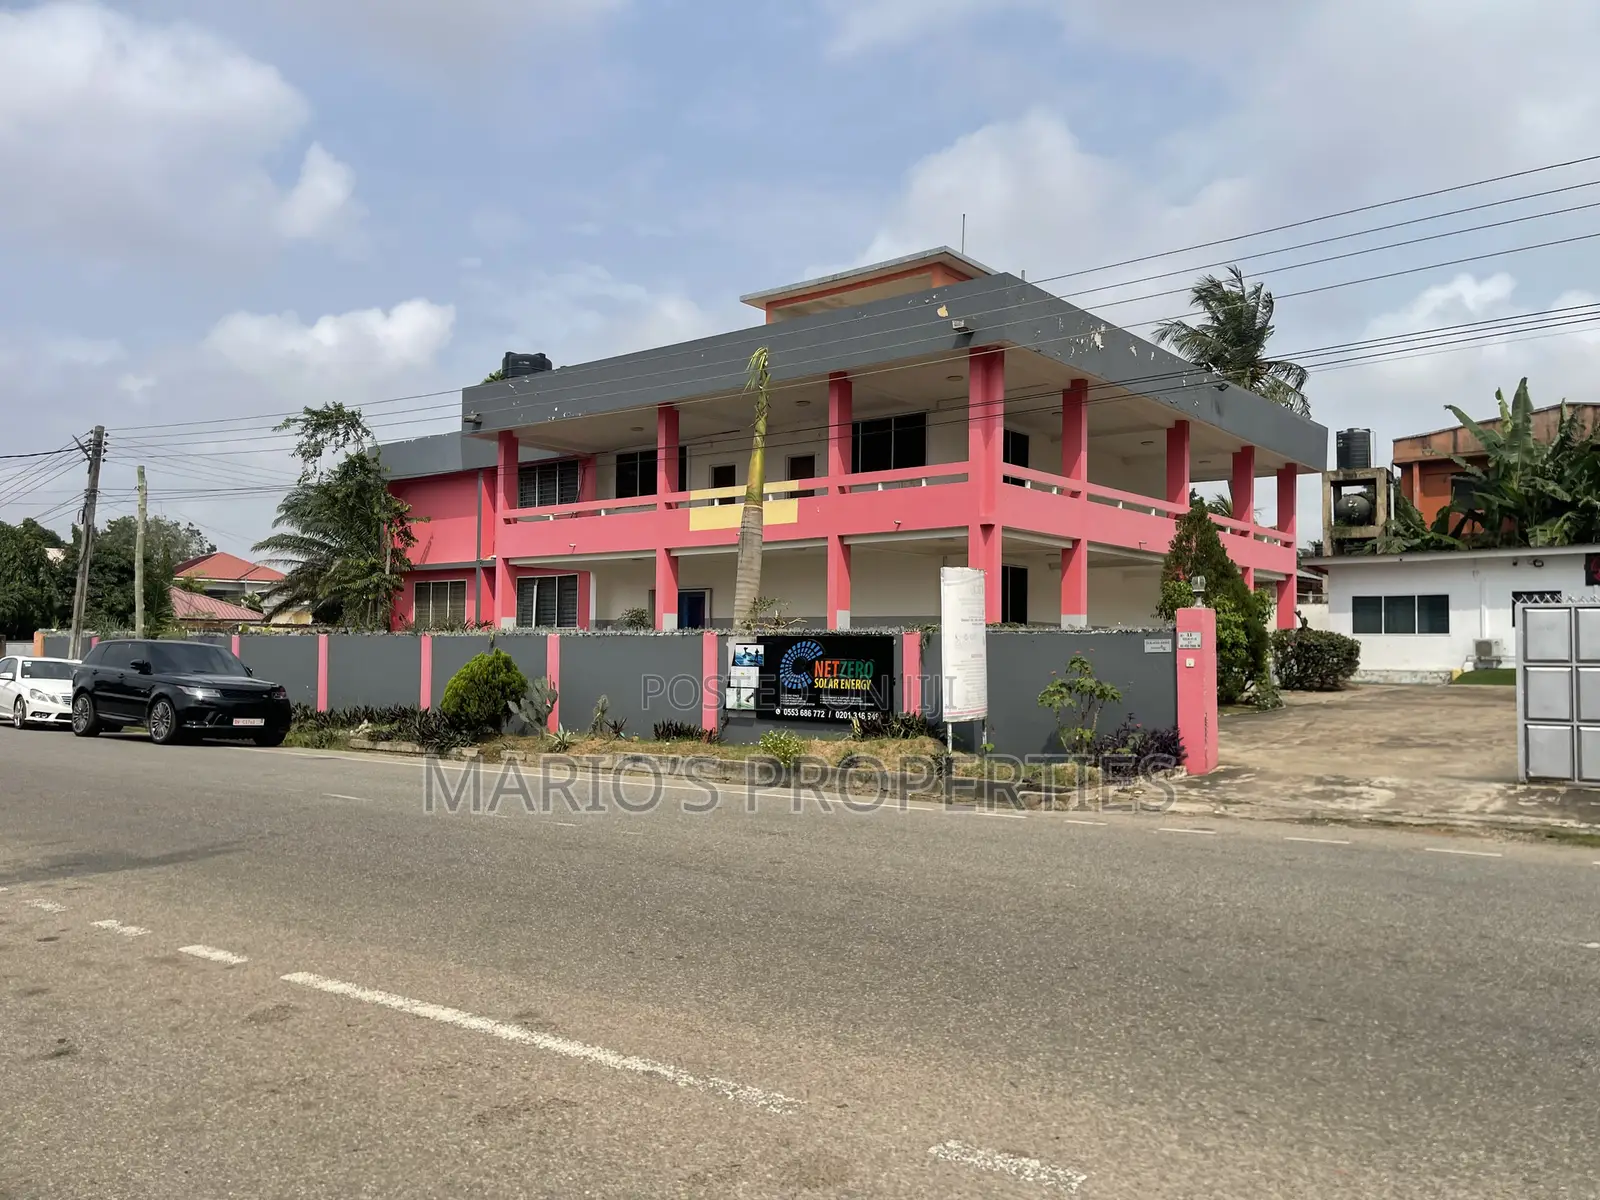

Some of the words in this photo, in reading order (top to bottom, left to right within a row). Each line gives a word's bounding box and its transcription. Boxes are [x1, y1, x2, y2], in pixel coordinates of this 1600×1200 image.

[814, 660, 874, 679] NETZERO
[814, 678, 839, 689] SOLAR
[840, 679, 872, 691] ENERGY
[783, 707, 799, 717] 0553
[813, 709, 825, 718] 772
[835, 710, 852, 719] 0201
